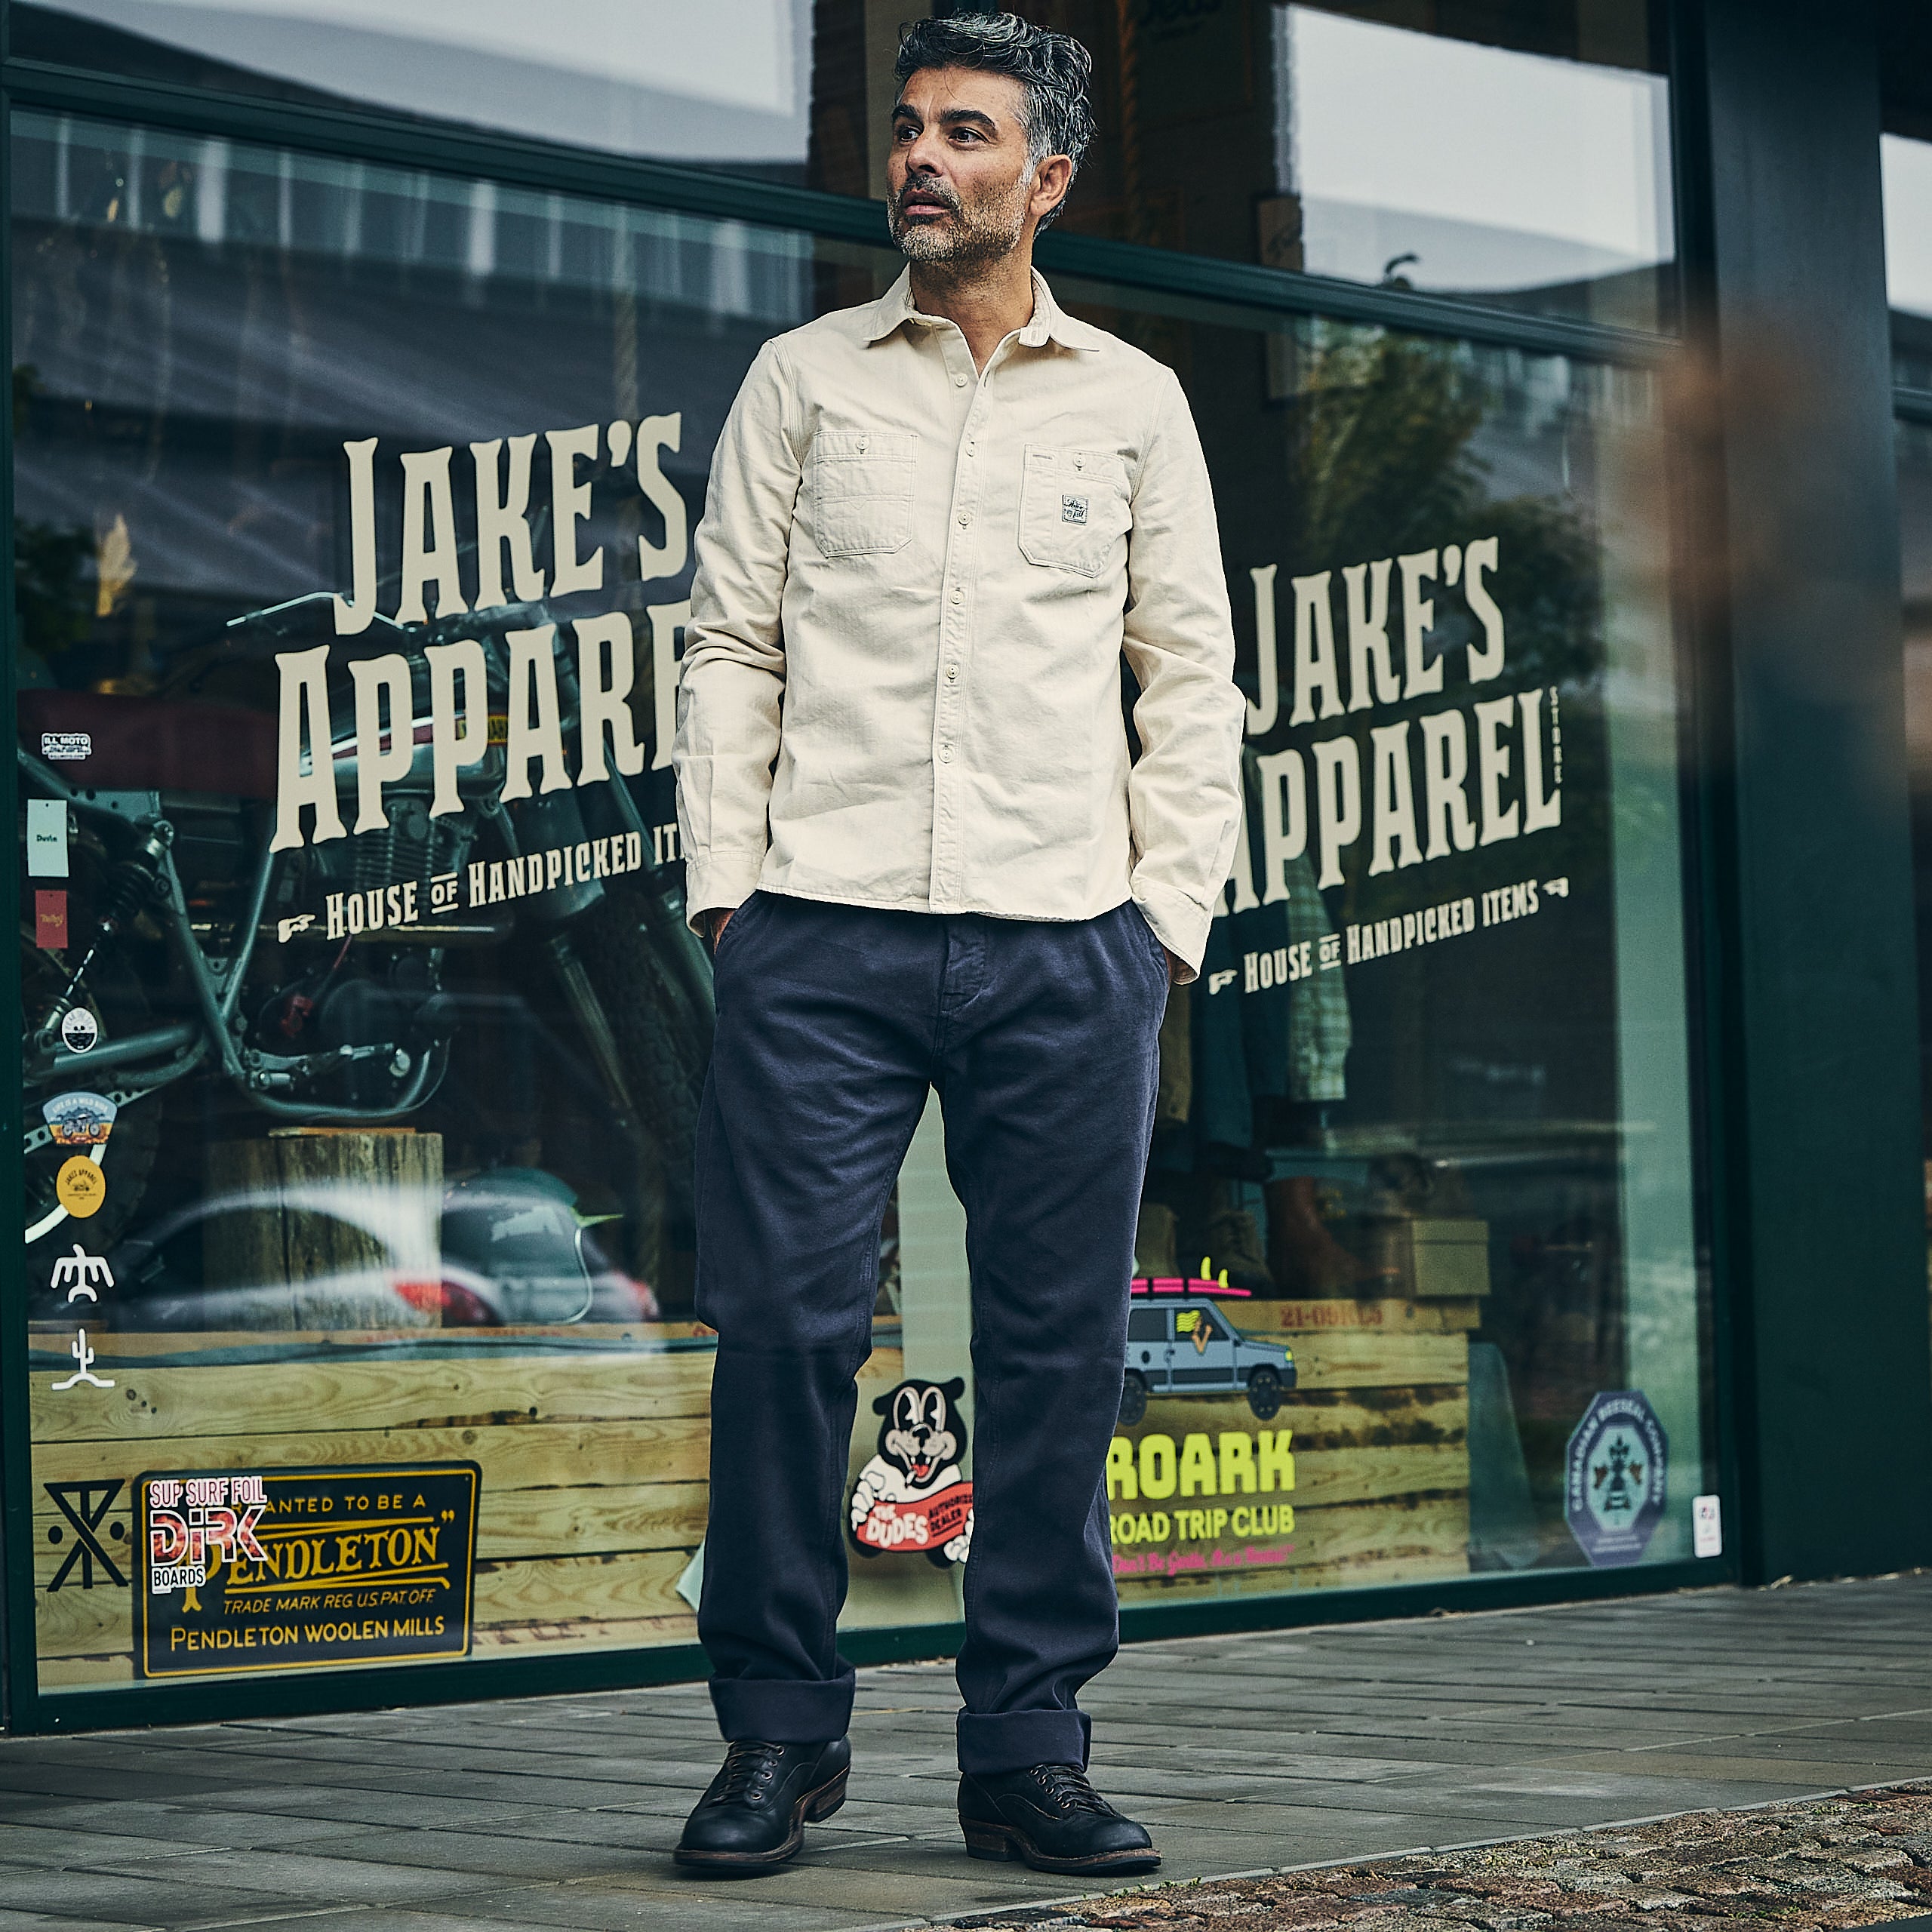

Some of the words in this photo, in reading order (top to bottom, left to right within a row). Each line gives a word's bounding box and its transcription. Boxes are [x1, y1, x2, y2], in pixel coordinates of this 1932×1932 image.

[334, 412, 688, 635] JAKE'S
[1247, 537, 1506, 736] JAKE'S
[325, 881, 418, 940] HOUSE
[431, 876, 458, 908] OF
[468, 832, 641, 907] HANDPICKED
[1244, 941, 1312, 994] HOUSE
[1319, 938, 1340, 966] OF
[1346, 897, 1475, 964] HANDPICKED
[1482, 879, 1539, 928] ITEMS
[1106, 1429, 1296, 1500] ROARK
[152, 1481, 182, 1506] SUP
[186, 1478, 228, 1505] SURF
[232, 1477, 266, 1503] FOIL
[344, 1496, 369, 1511] TO
[377, 1494, 403, 1509] BE
[413, 1494, 426, 1508] A
[866, 1512, 929, 1547] DUDES
[1174, 1508, 1229, 1540] TRIP
[1232, 1504, 1296, 1537] CLUB
[153, 1567, 204, 1587] BOARDS
[223, 1598, 271, 1615] TRADE
[275, 1595, 320, 1612] MARK
[171, 1624, 298, 1652] PENDLETON
[303, 1620, 389, 1644] WOOLEN
[393, 1615, 445, 1638] MILLS
